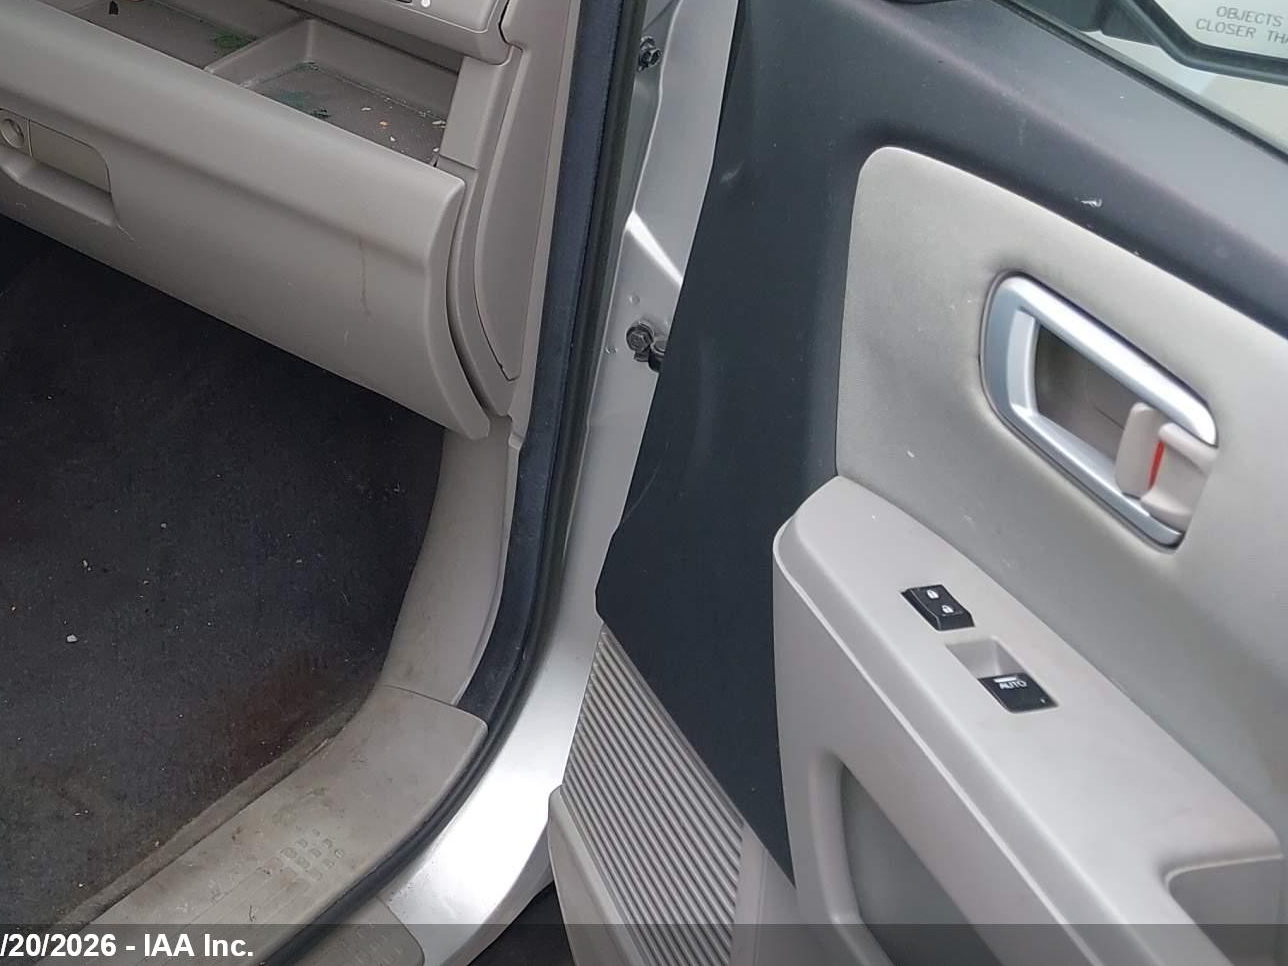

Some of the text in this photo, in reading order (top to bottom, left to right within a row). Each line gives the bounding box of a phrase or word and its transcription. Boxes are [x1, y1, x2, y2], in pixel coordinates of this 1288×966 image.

[1216, 6, 1284, 27] OBJECTS
[1196, 18, 1257, 39] CLOSER
[999, 680, 1028, 690] AUTO
